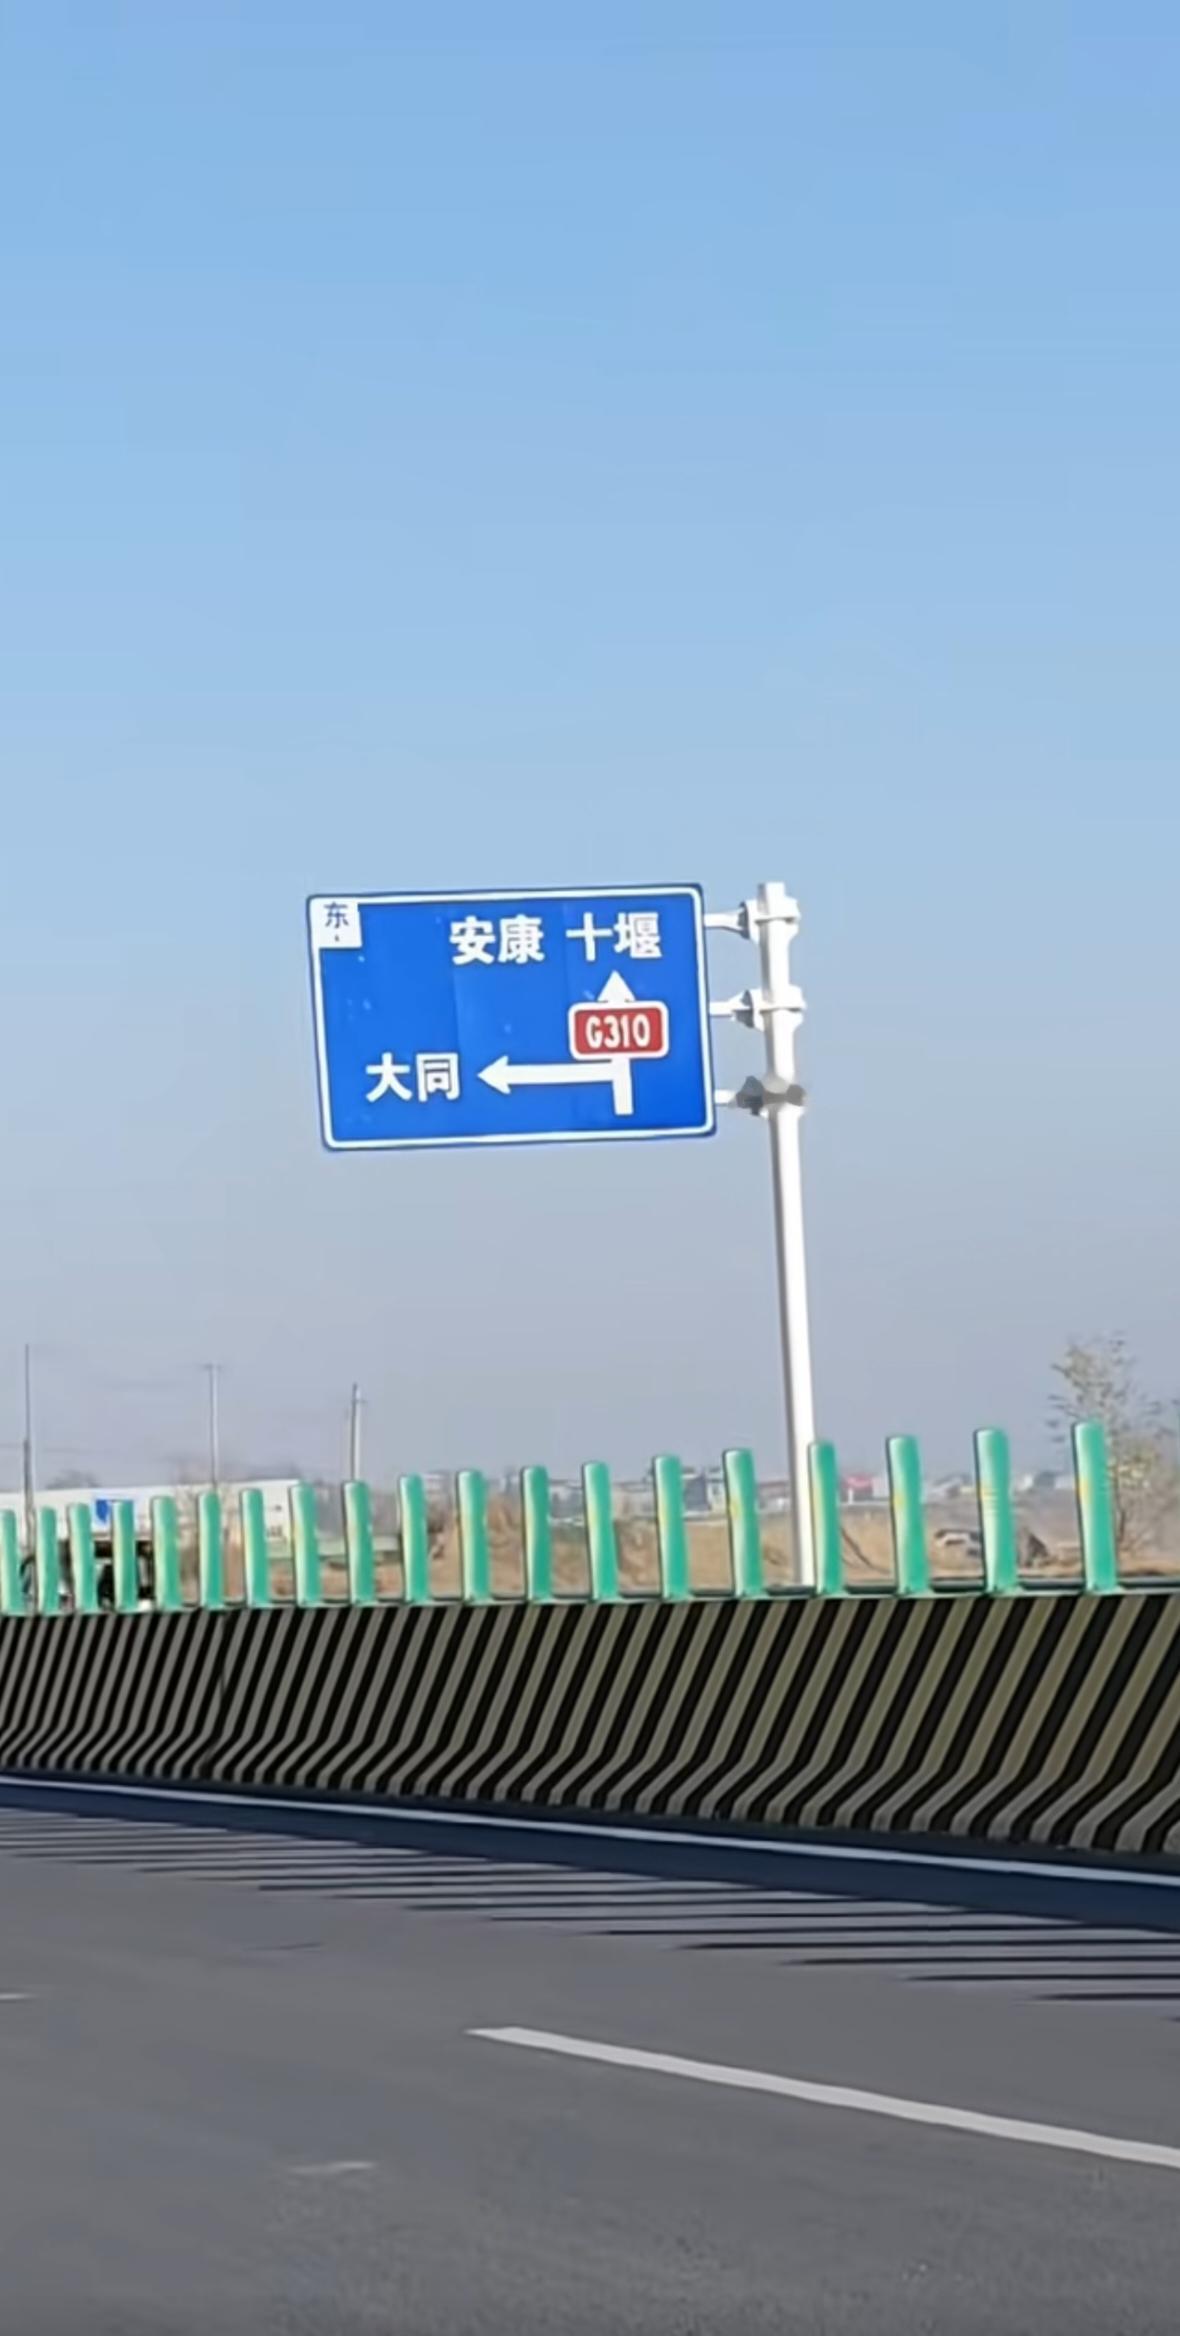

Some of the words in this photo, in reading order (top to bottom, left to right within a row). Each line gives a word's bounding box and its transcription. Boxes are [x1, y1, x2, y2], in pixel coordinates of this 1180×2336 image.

[323, 901, 349, 929] 东
[449, 914, 545, 964] 安康
[566, 911, 663, 961] 十堰
[585, 1013, 651, 1049] G310
[365, 1053, 460, 1102] 大同
